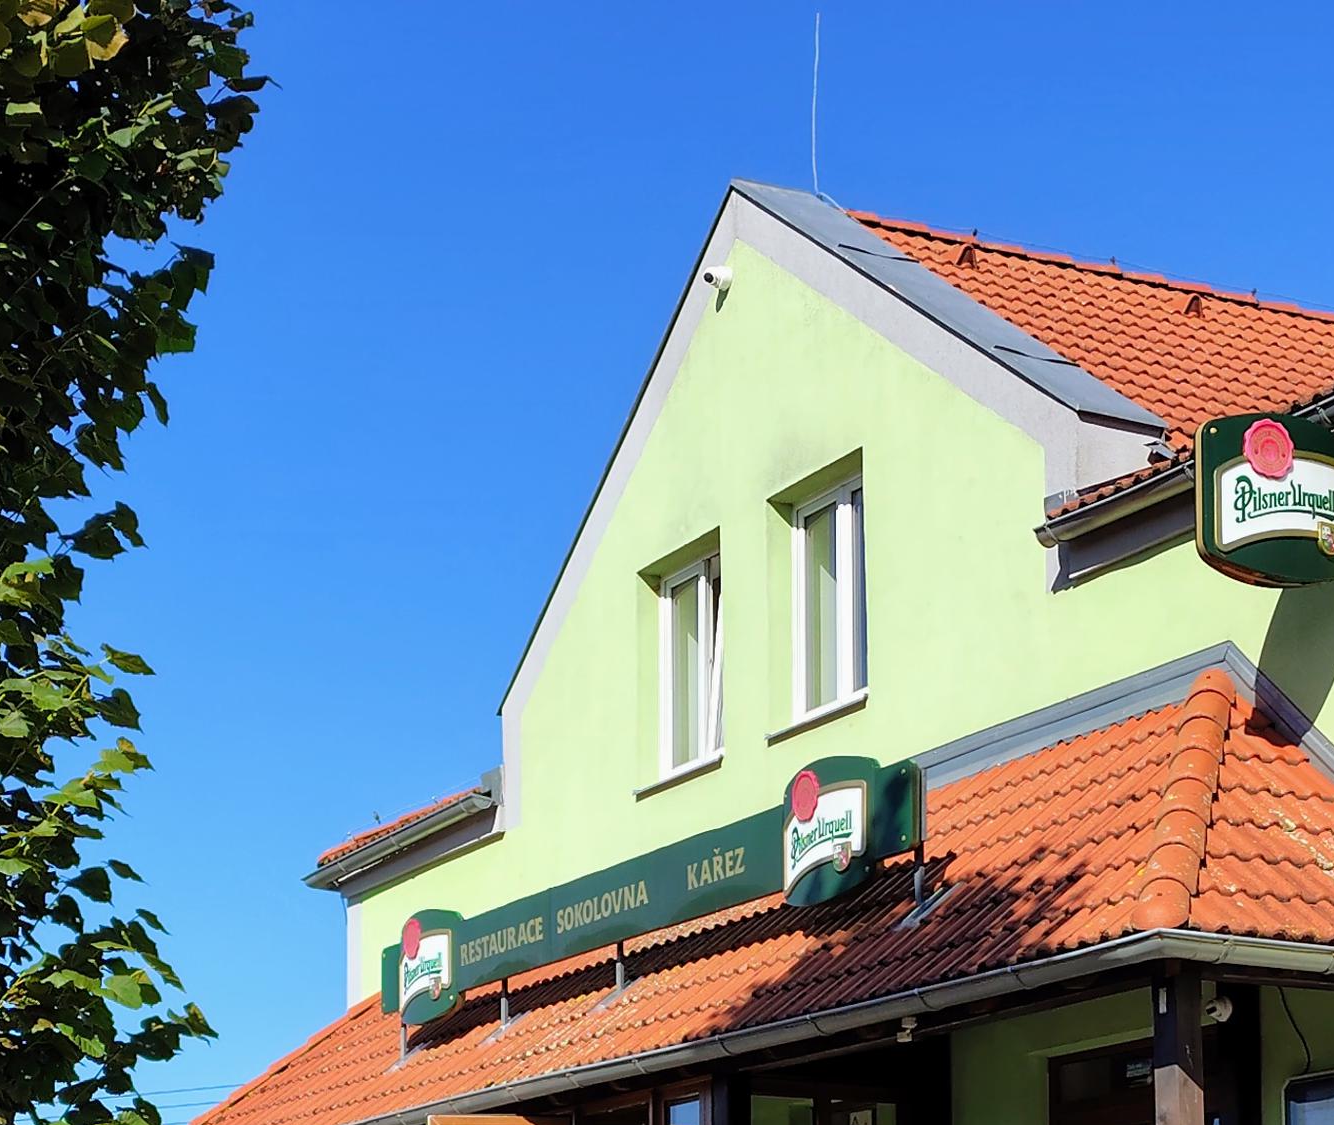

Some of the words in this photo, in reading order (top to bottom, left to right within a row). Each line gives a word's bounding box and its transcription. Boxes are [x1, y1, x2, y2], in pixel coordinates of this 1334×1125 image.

[1233, 475, 1291, 523] Pilsner
[817, 809, 852, 843] Urquell
[460, 916, 544, 967] RESTAURACE
[556, 880, 649, 934] SOKOLOVNA
[686, 847, 746, 891] KAŘEZ
